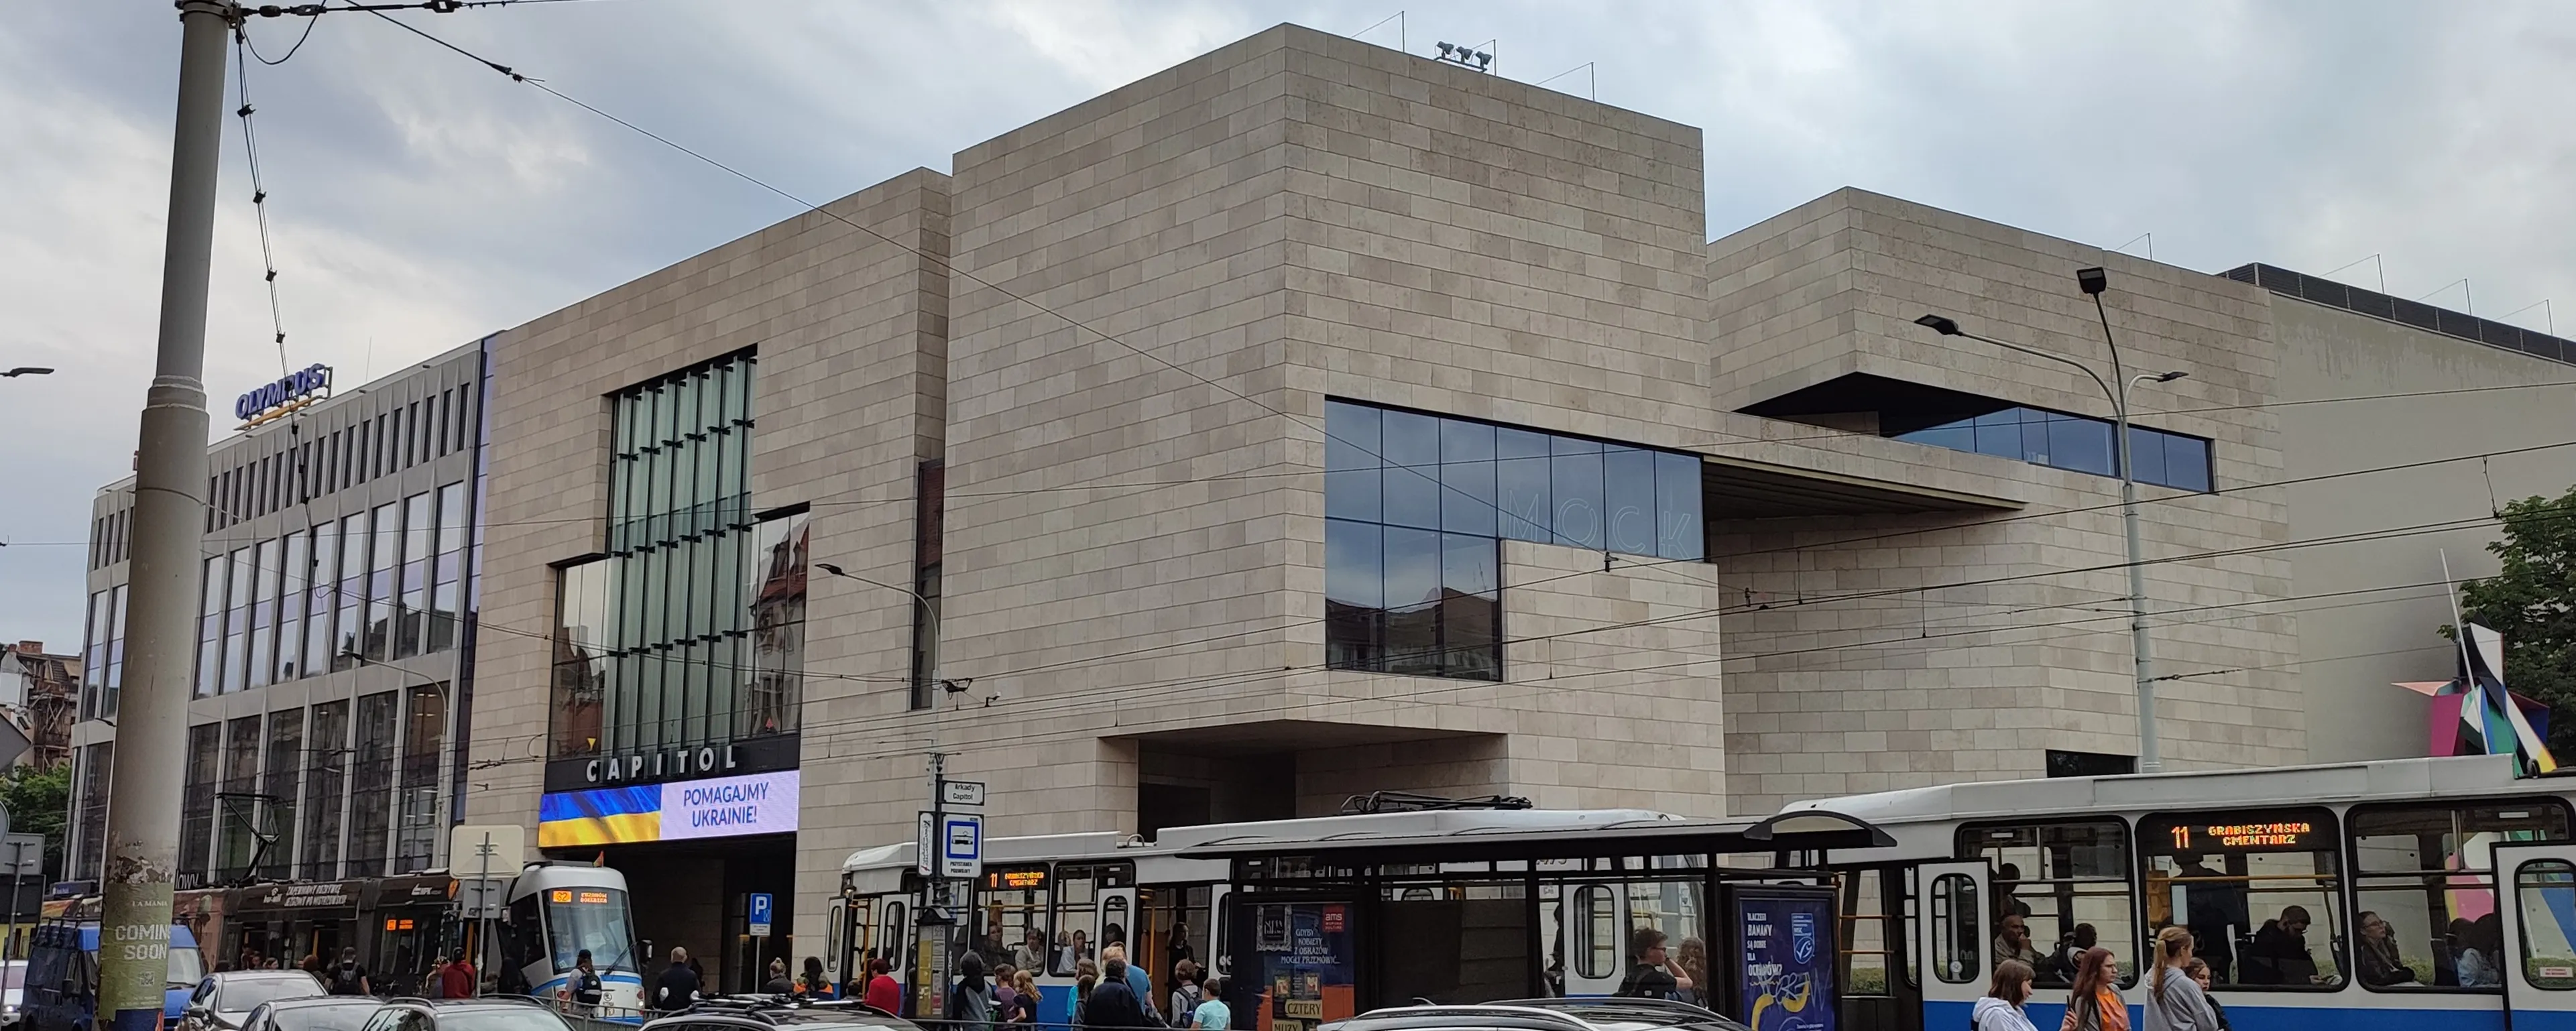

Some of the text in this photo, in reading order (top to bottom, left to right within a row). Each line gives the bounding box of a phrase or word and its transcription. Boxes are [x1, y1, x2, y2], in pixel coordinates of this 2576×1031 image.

[235, 363, 325, 420] OLYMPUS
[1509, 489, 1691, 559] MOCK
[586, 745, 736, 783] CAPITOL
[683, 782, 770, 807] POMAGAJMY
[954, 783, 976, 792] Arkady
[953, 792, 973, 800] Capitol
[691, 805, 758, 827] UKRAINIE!
[2170, 822, 2310, 849] 11 GRABISZYŃSKA
[2222, 834, 2296, 847] CMENTARZ
[990, 872, 998, 888] 11
[755, 896, 768, 915] P
[1325, 913, 1342, 921] ams
[1295, 928, 1314, 936] GDYBY
[1747, 924, 1772, 936] BANANY
[123, 943, 167, 960] SOON
[1300, 945, 1328, 955] OBRAZÓW
[1287, 1002, 1321, 1015] CZTERY
